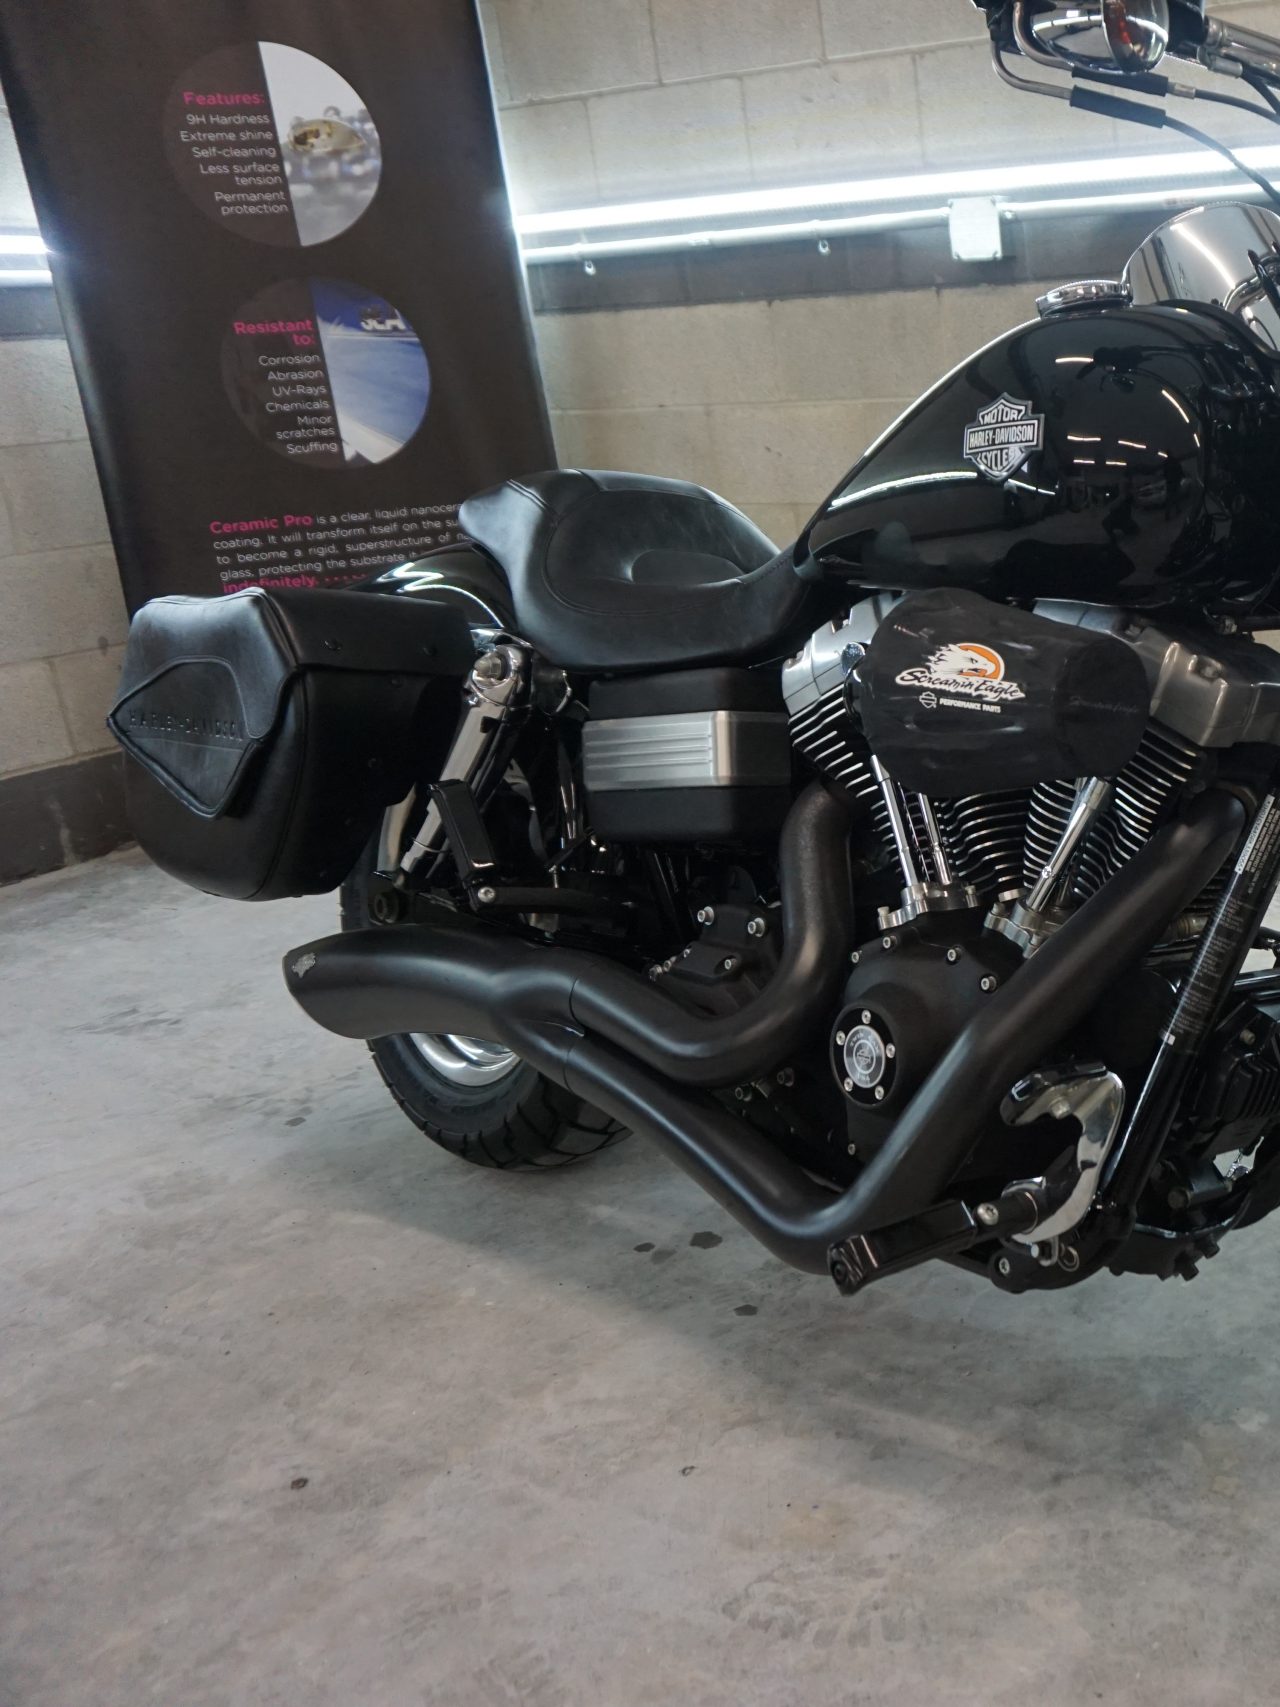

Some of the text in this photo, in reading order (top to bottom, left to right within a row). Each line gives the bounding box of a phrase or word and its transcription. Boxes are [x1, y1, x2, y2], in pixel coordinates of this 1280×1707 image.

[183, 91, 265, 105] Features:
[186, 113, 270, 125] 9H Hardness
[180, 130, 273, 142] Extreme shine
[192, 146, 277, 158] Self-cleaning
[200, 162, 280, 174] Less surface
[234, 175, 282, 185] tension
[214, 191, 286, 202] Permanent
[221, 204, 289, 216] protection
[233, 319, 313, 335] Resistant
[292, 333, 315, 345] to:
[258, 354, 320, 366] Corrosion
[267, 369, 324, 381] Abrasion
[272, 384, 327, 397] UV-Rays
[265, 399, 330, 413] Chemicals
[297, 414, 333, 425] Minor
[983, 404, 1019, 424] MOTOR
[276, 426, 335, 439] scratches
[969, 425, 1034, 448] HARLEY-DAVIDSON
[287, 441, 338, 454] Scuffing
[209, 517, 279, 534] Ceramic
[283, 514, 312, 527] Pro
[316, 514, 326, 524] is
[329, 514, 337, 524] a
[374, 506, 408, 519] liquid
[268, 534, 277, 544] It
[281, 531, 301, 543] will
[306, 526, 365, 541] transform
[369, 522, 398, 534] itself
[402, 522, 418, 531] on
[422, 519, 441, 529] the
[216, 555, 230, 564] to
[237, 549, 288, 563] become
[294, 548, 302, 557] a
[345, 535, 432, 552] superstructure
[438, 532, 451, 543] of
[258, 560, 322, 576] protecting
[326, 558, 346, 569] the
[350, 552, 405, 566] substrate
[974, 679, 1020, 700] Eagle
[939, 698, 1002, 714] PERFORMANCE PARTS
